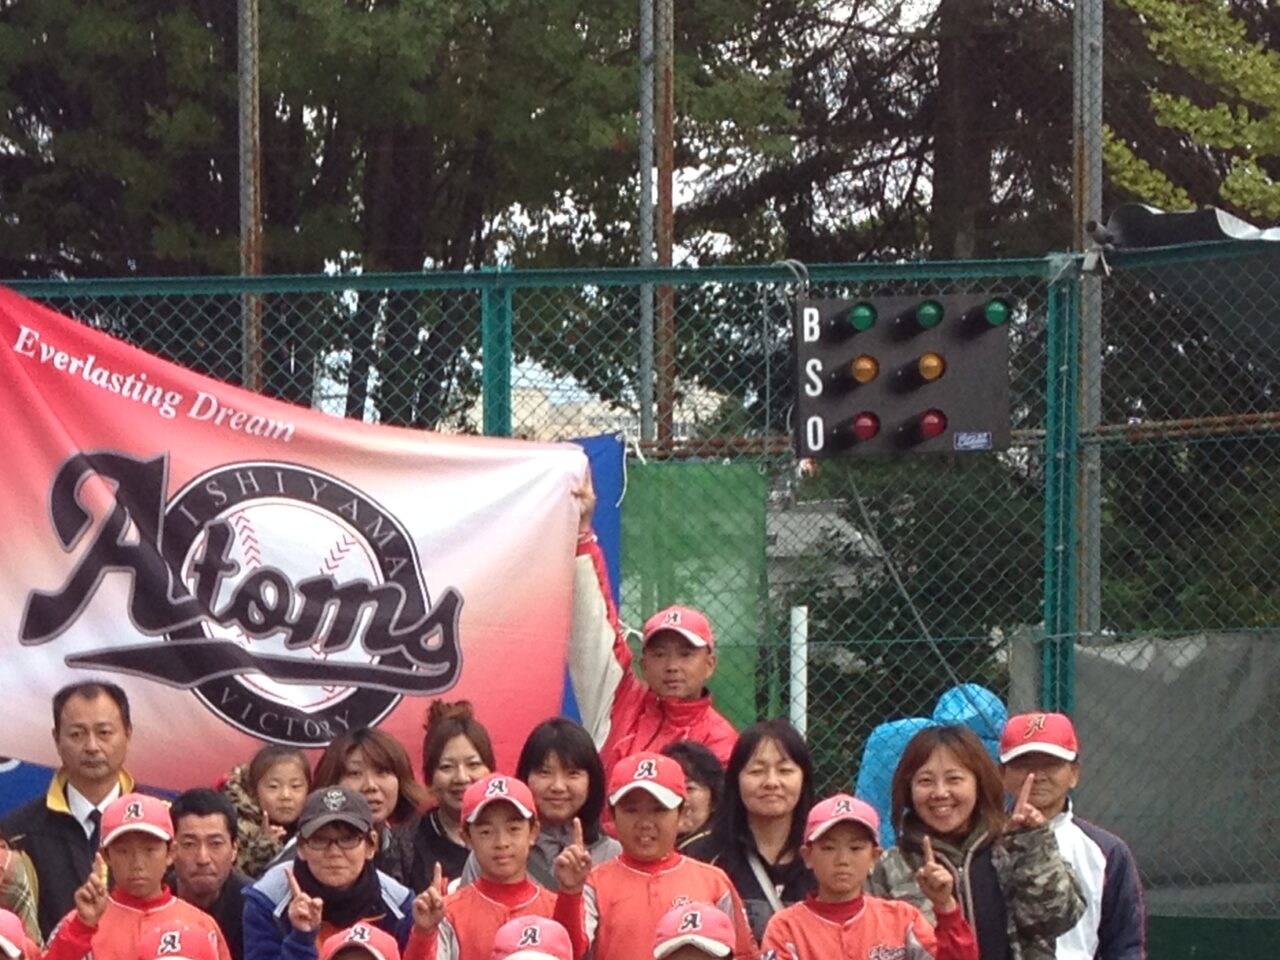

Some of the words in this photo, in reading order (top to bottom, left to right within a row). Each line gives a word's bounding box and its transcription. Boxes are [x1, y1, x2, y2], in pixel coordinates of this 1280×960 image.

[803, 307, 820, 342] B
[13, 324, 183, 419] Everlasting
[187, 391, 296, 442] Dream
[804, 358, 823, 397] S
[178, 470, 408, 578] ISHIYAMA
[20, 449, 464, 694] Atoms
[221, 686, 352, 738] VICTORY
